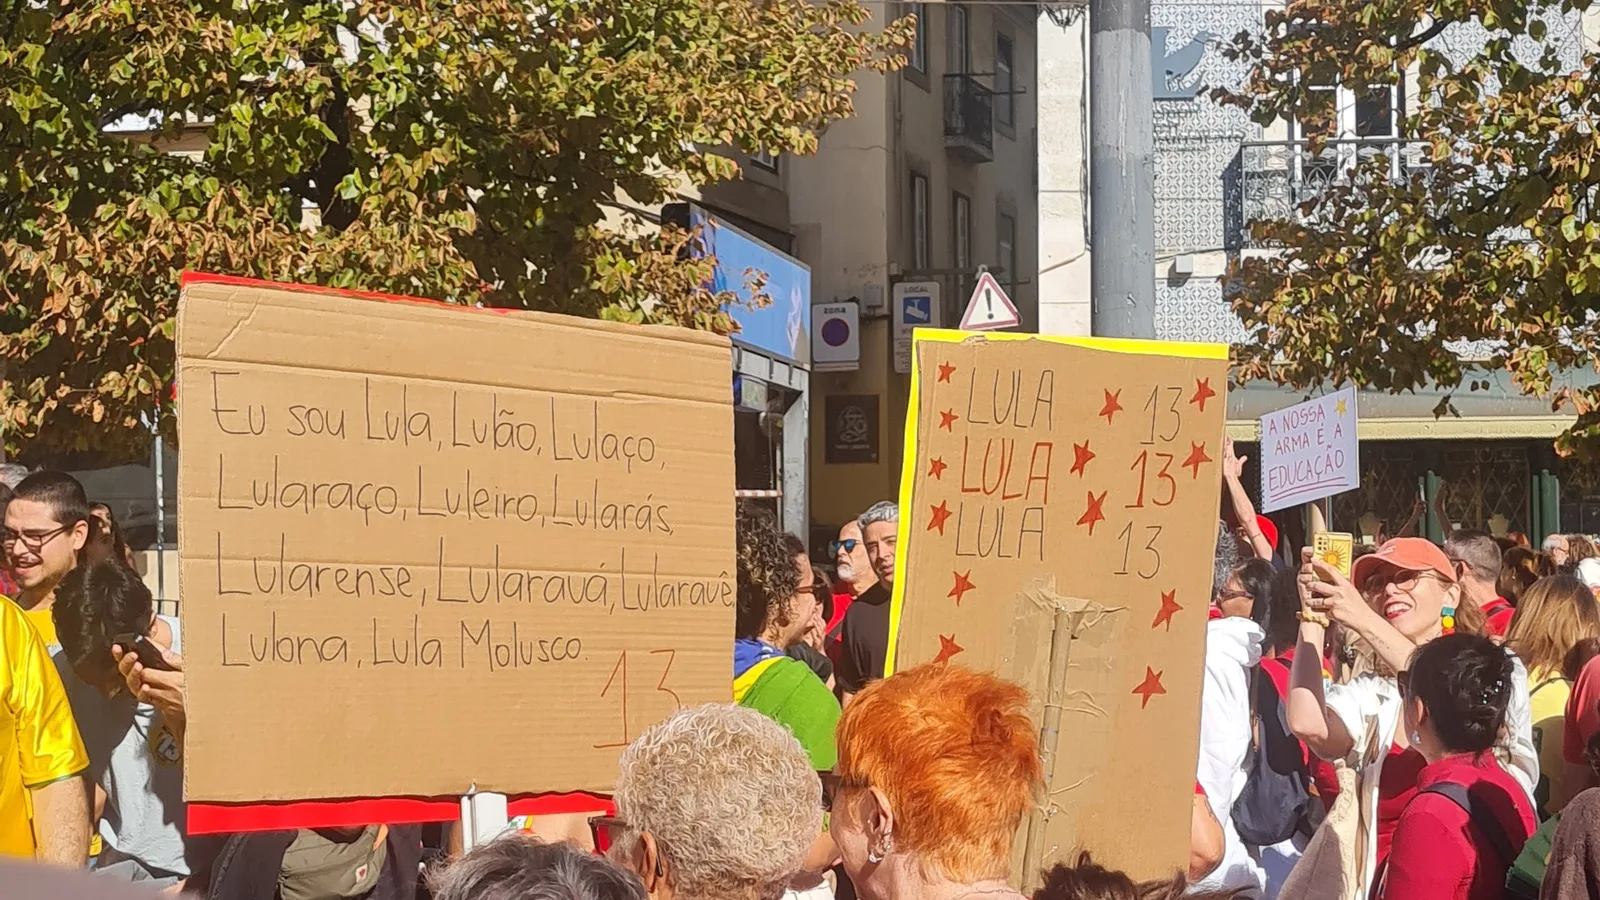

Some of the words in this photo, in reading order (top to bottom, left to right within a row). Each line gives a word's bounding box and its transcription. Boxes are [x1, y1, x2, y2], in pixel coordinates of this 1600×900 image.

[211, 371, 265, 435] Eu
[287, 404, 345, 436] sou
[365, 377, 442, 452] Lula,
[551, 396, 665, 473] Lulaço,
[967, 367, 1054, 431] LULA
[1140, 385, 1182, 445] 13
[1269, 418, 1278, 436] A
[1283, 403, 1326, 433] NOSSA
[1275, 432, 1310, 456] ARMA
[1317, 423, 1325, 446] É
[1334, 422, 1342, 440] A
[218, 453, 406, 526] Lularaço,
[417, 465, 545, 528] Luleiro,
[553, 474, 674, 536] Lularás,
[961, 436, 1053, 505] LULA
[1125, 450, 1176, 508] 13
[1268, 443, 1345, 492] EDUCAÇÃO
[217, 531, 427, 607] Lularense,
[955, 502, 1044, 561] LULA
[1114, 521, 1162, 579] 13
[373, 614, 443, 668] Lula
[461, 619, 589, 672] Molusco.
